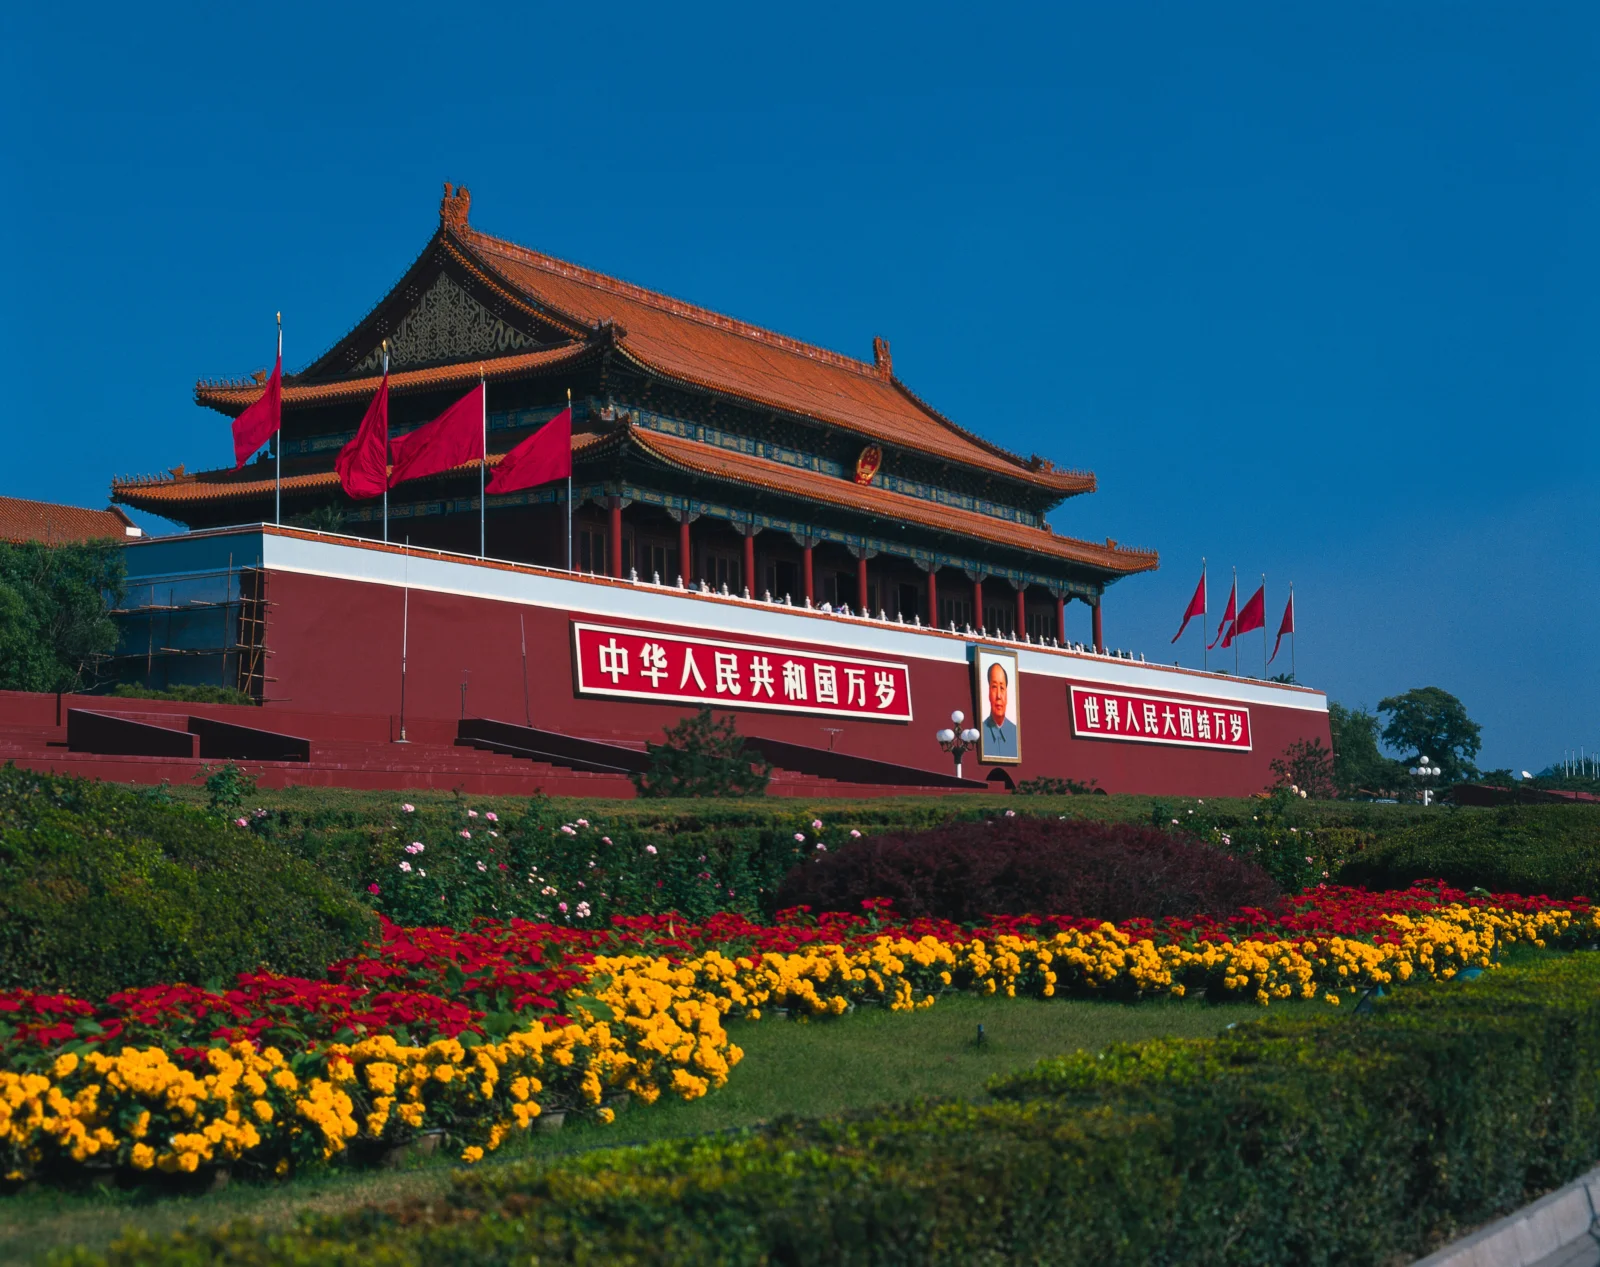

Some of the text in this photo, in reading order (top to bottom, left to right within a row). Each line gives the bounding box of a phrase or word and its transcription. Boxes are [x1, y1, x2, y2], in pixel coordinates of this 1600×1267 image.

[598, 638, 896, 709] 中华人民共和国万岁
[1084, 696, 1243, 742] 世界人民大团结万岁
